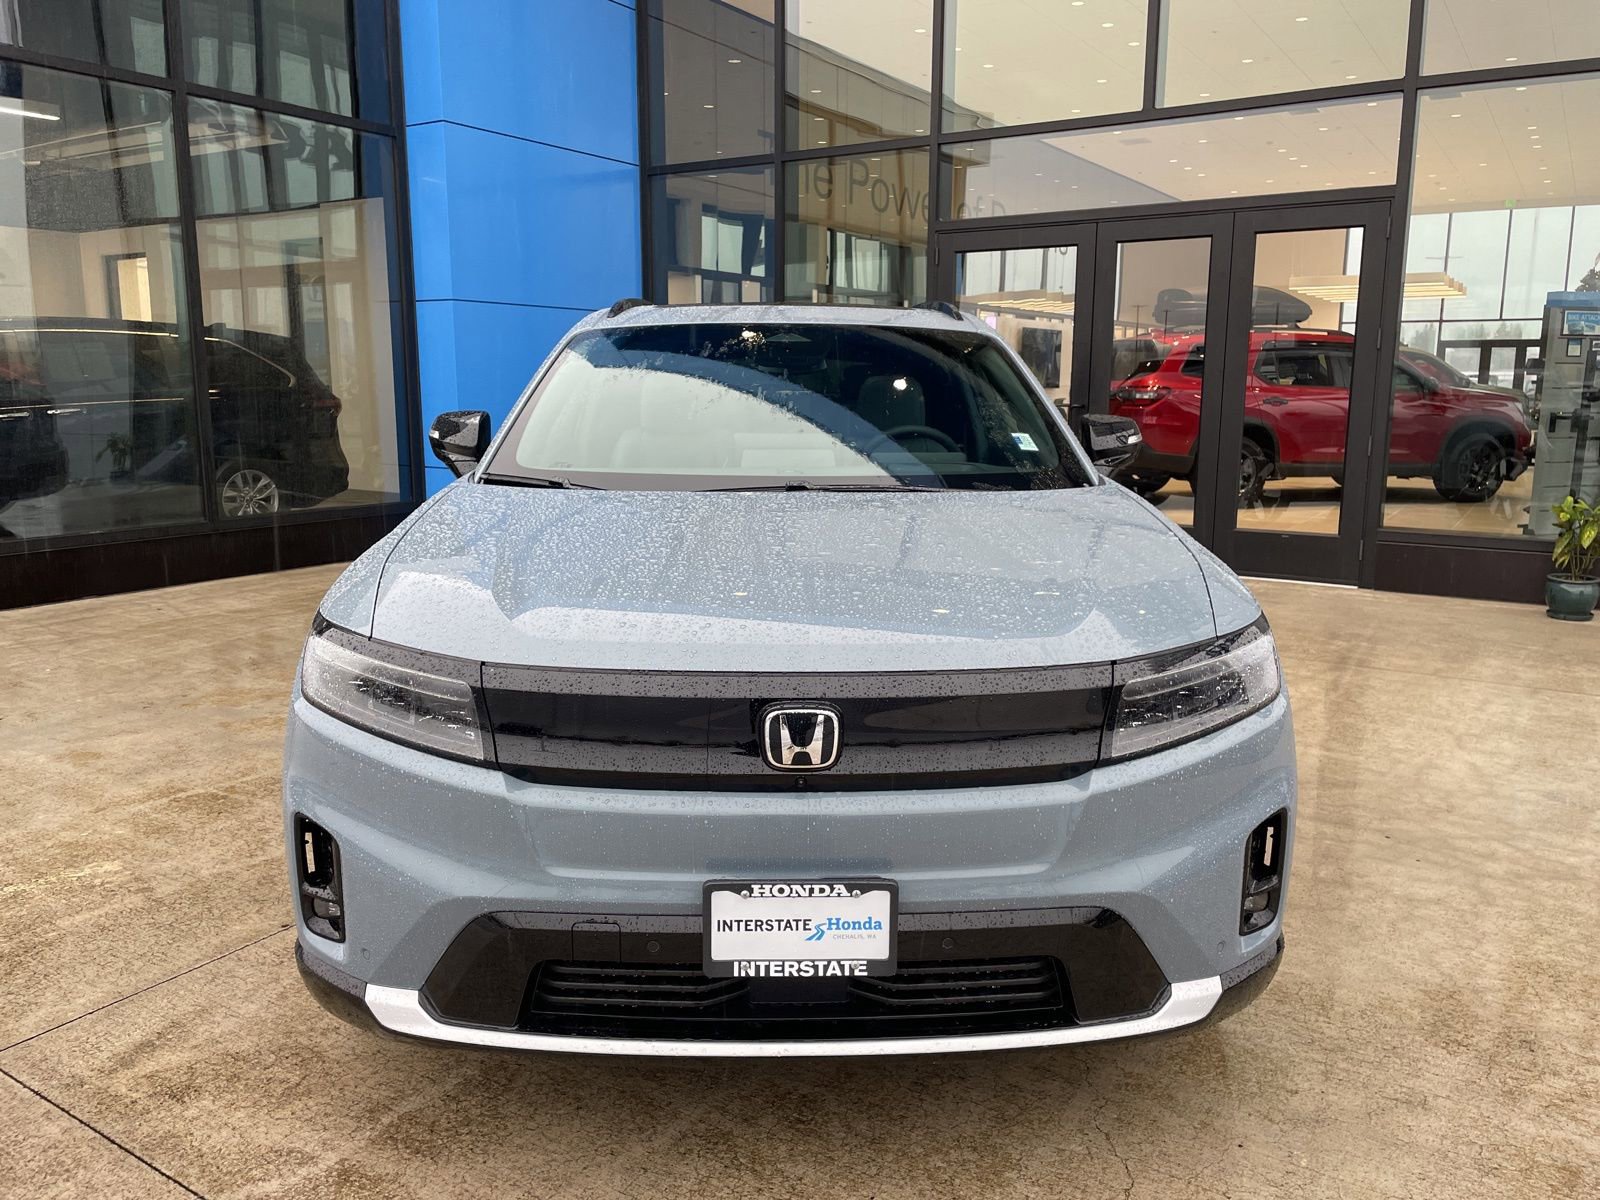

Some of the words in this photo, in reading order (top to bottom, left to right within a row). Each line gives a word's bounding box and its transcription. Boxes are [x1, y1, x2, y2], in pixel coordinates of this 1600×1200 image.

[751, 884, 850, 897] HONDA
[717, 918, 812, 932] INTERSTATE
[826, 916, 882, 931] Honda
[733, 960, 868, 977] INTERSTATE
